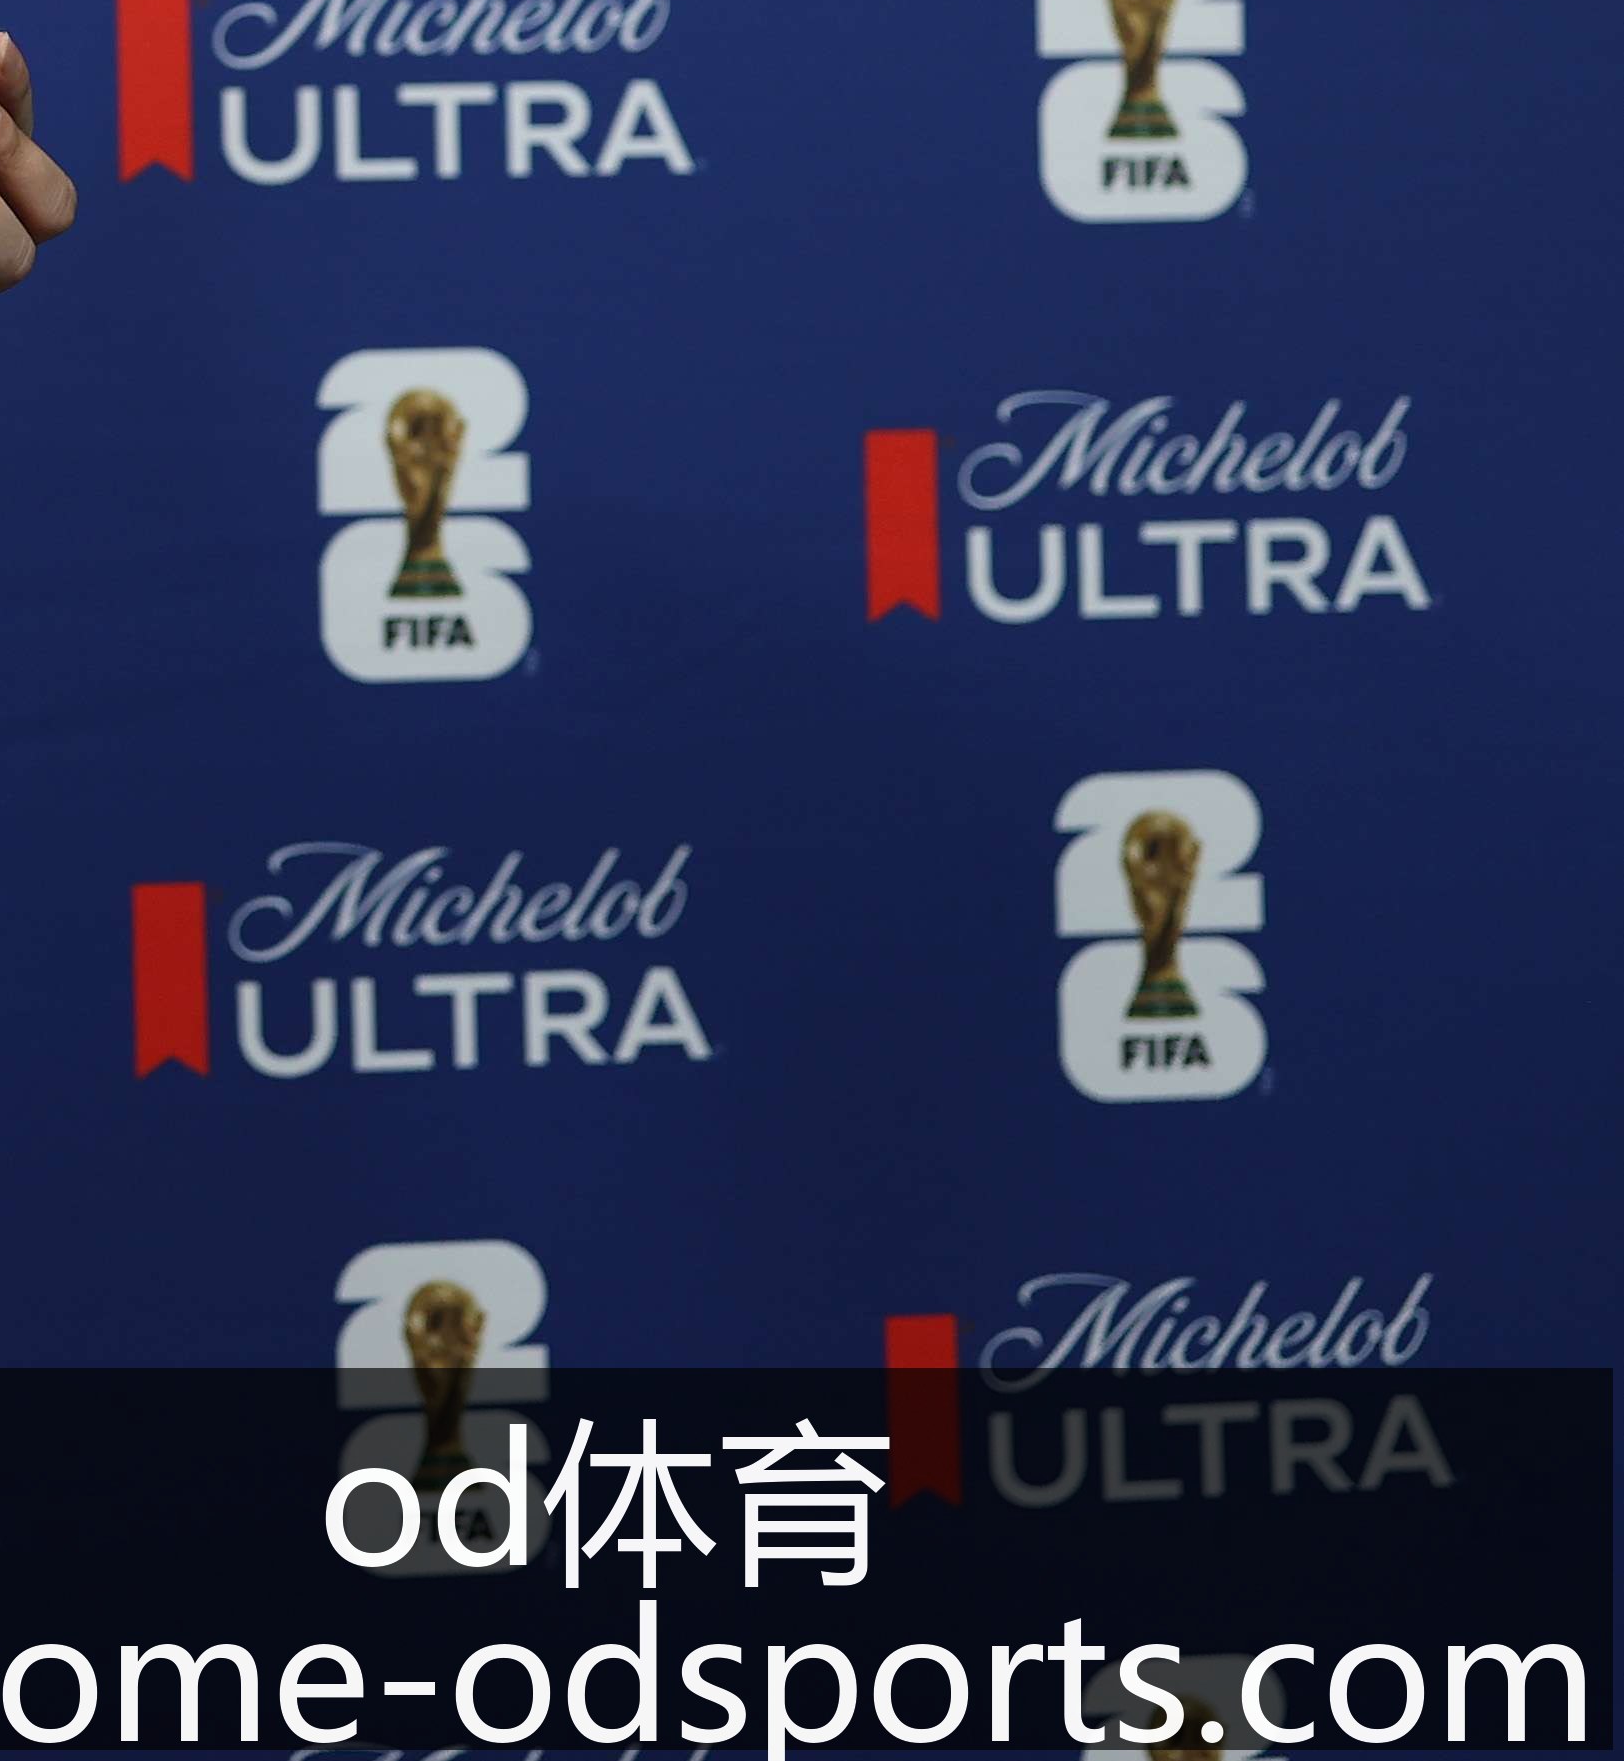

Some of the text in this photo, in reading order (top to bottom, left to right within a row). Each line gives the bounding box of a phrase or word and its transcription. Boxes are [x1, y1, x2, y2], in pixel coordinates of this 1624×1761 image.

[221, 78, 694, 185] ULTRA
[1101, 156, 1191, 189] FIFA
[961, 390, 1410, 510] Michelob
[966, 515, 1430, 624] ULTRA
[382, 614, 475, 650] FIFA
[236, 842, 690, 963] Michelob
[236, 966, 711, 1078] ULTRA
[1120, 1034, 1211, 1070] FIFA
[988, 1394, 1454, 1507] ULTRA
